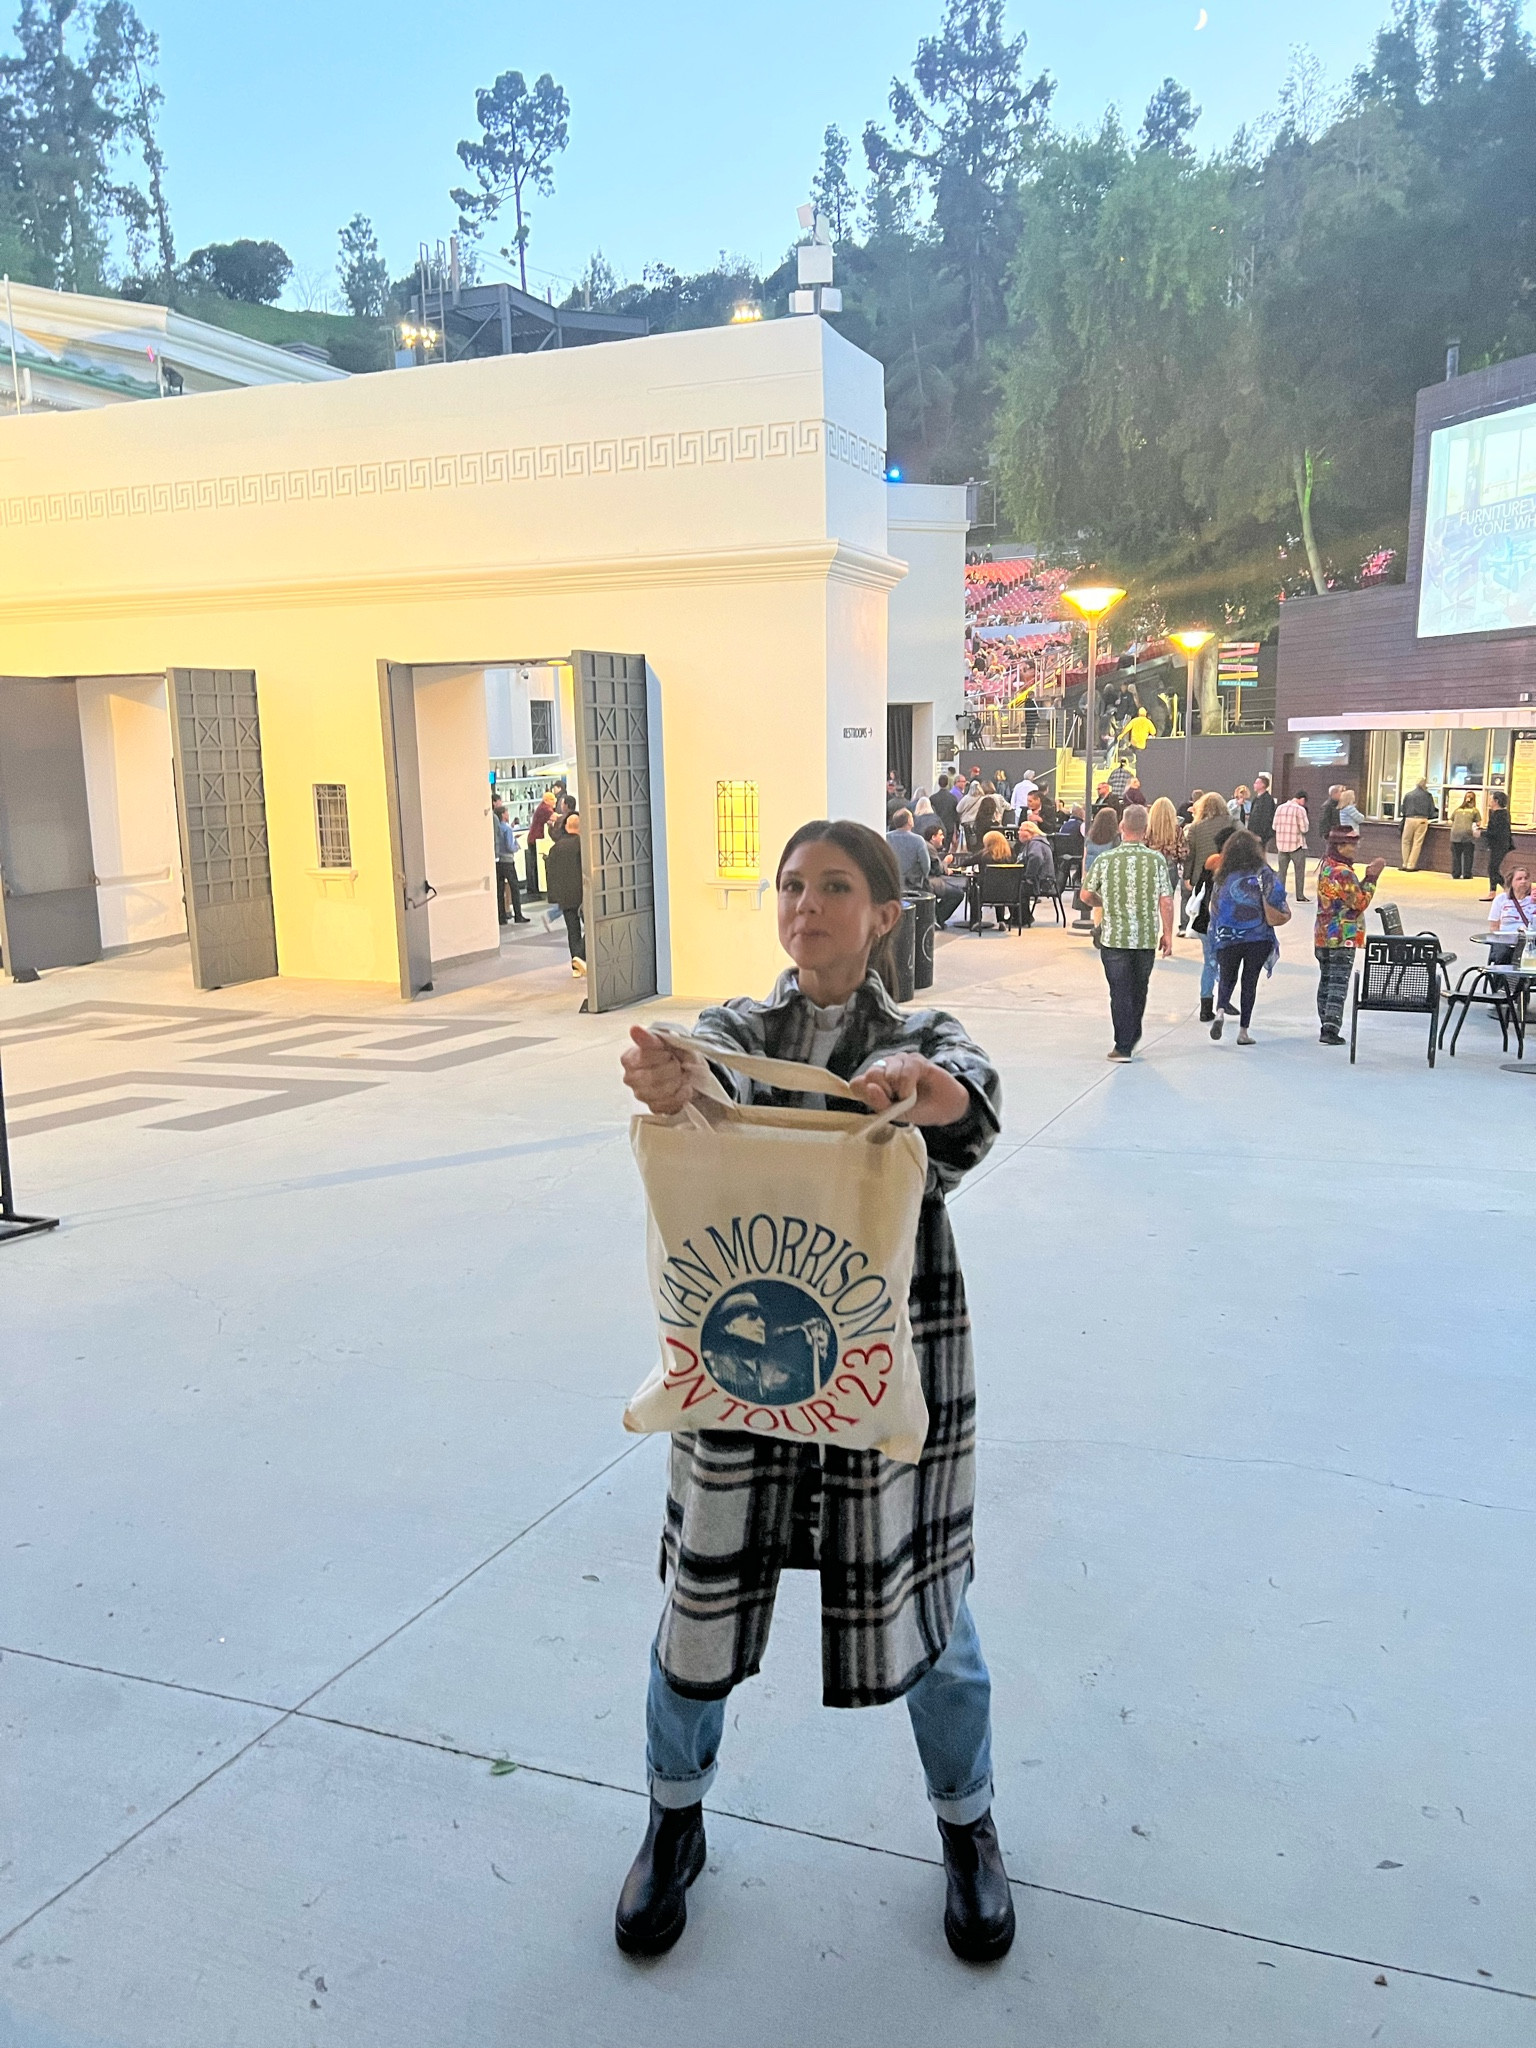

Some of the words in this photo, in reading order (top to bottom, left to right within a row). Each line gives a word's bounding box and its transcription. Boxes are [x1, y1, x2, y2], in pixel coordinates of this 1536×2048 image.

[1473, 517, 1511, 537] GONE
[660, 1239, 722, 1328] VAN
[705, 1213, 896, 1341] MORRISON
